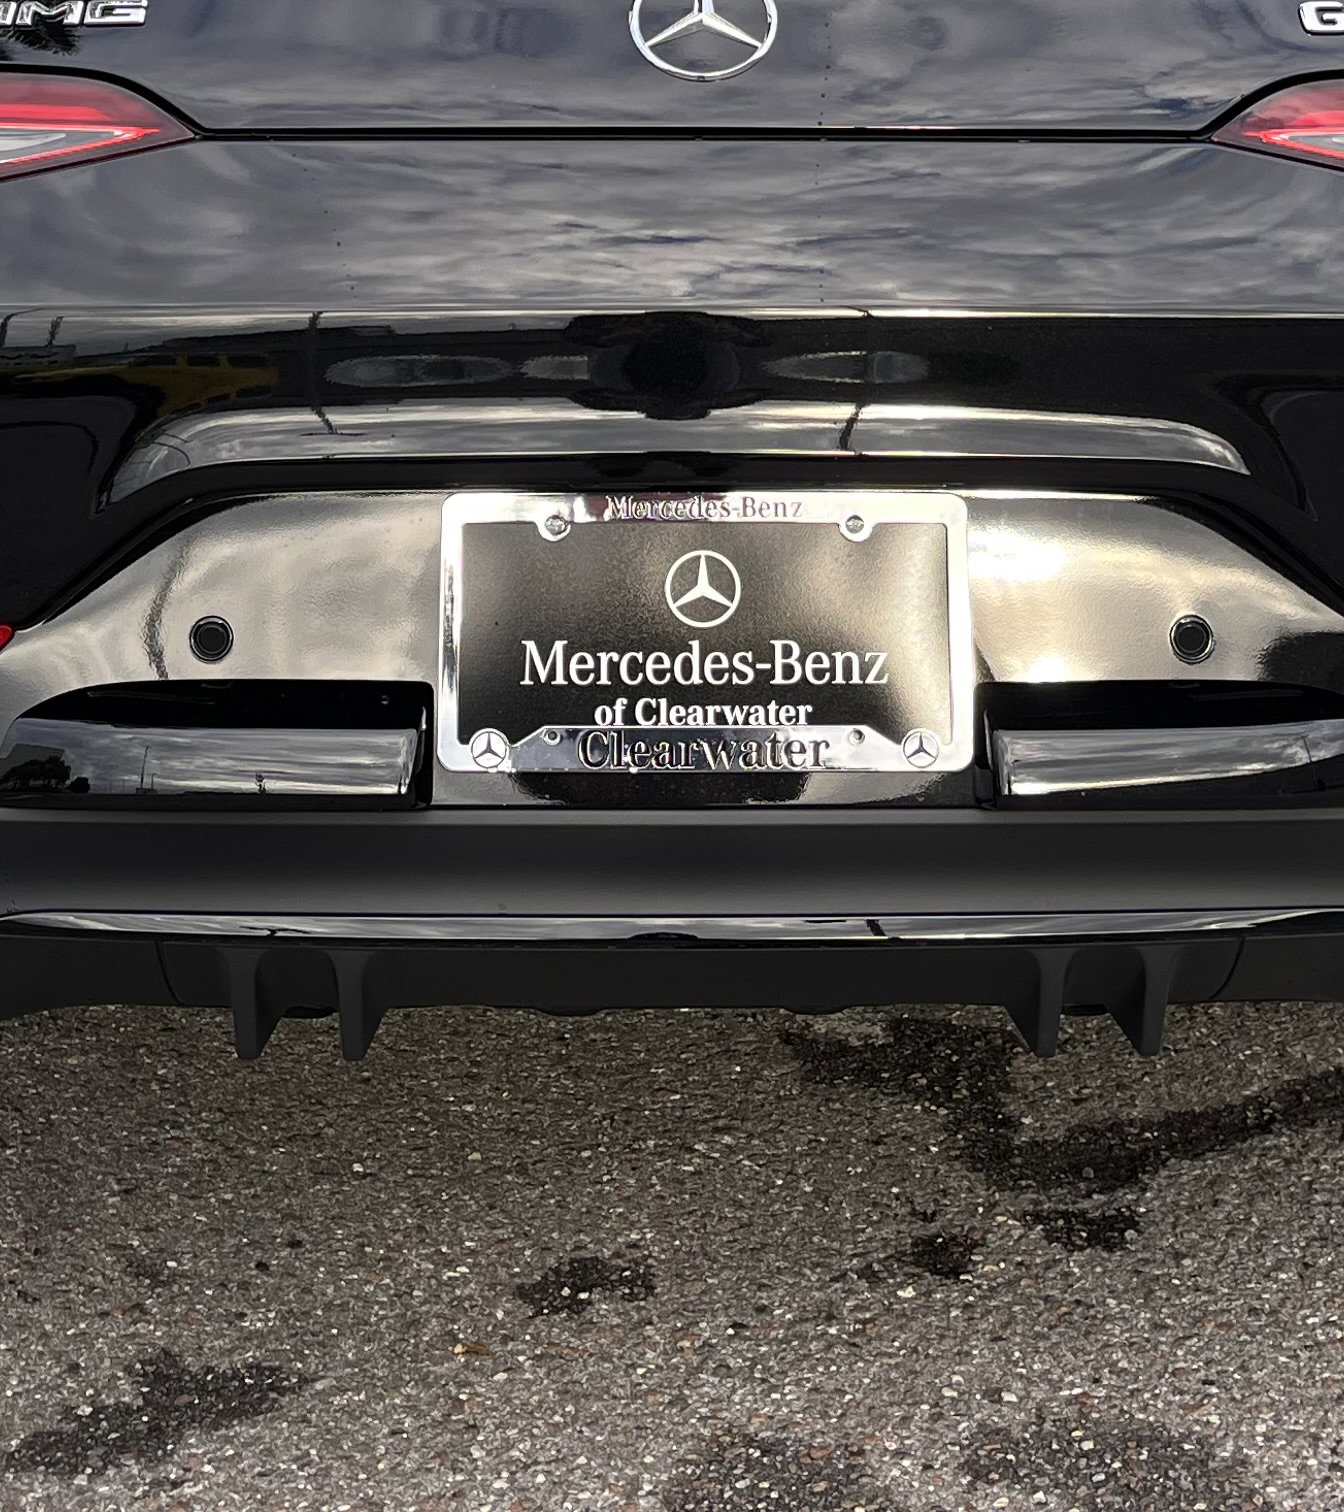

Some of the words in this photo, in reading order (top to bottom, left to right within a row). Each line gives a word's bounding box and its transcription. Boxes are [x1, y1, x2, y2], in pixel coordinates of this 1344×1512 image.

[605, 494, 804, 520] Mercedes-Benz
[519, 639, 889, 686] Mercedes-Benz
[594, 697, 629, 727] of
[634, 697, 813, 726] Clearwater
[578, 728, 831, 771] Clearwater
